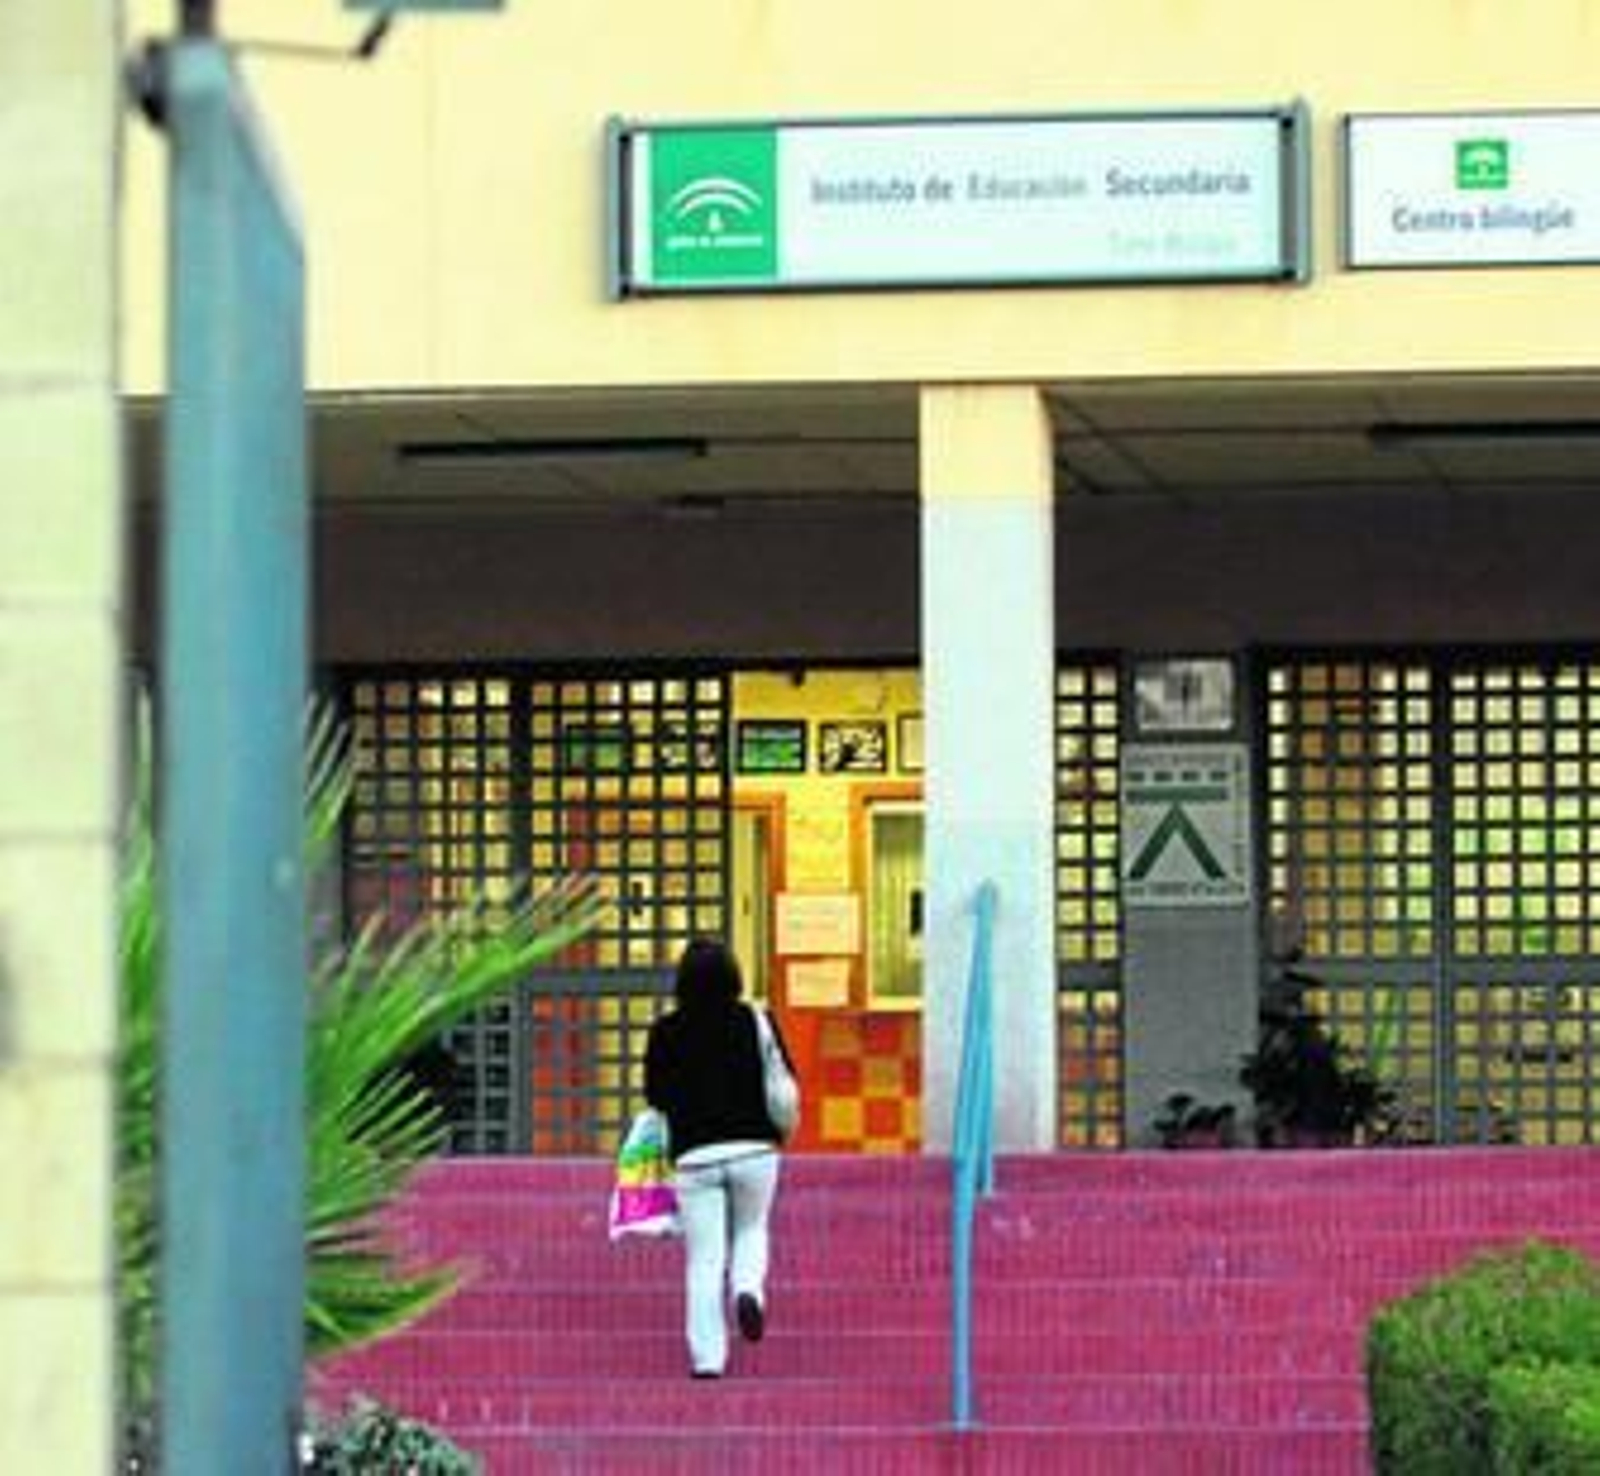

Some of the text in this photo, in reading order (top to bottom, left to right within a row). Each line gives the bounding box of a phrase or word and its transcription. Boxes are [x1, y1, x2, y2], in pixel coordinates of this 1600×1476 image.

[810, 173, 917, 203] Instituto
[922, 174, 954, 201] de
[1105, 165, 1251, 198] Secundaria
[1391, 204, 1476, 234] Centro
